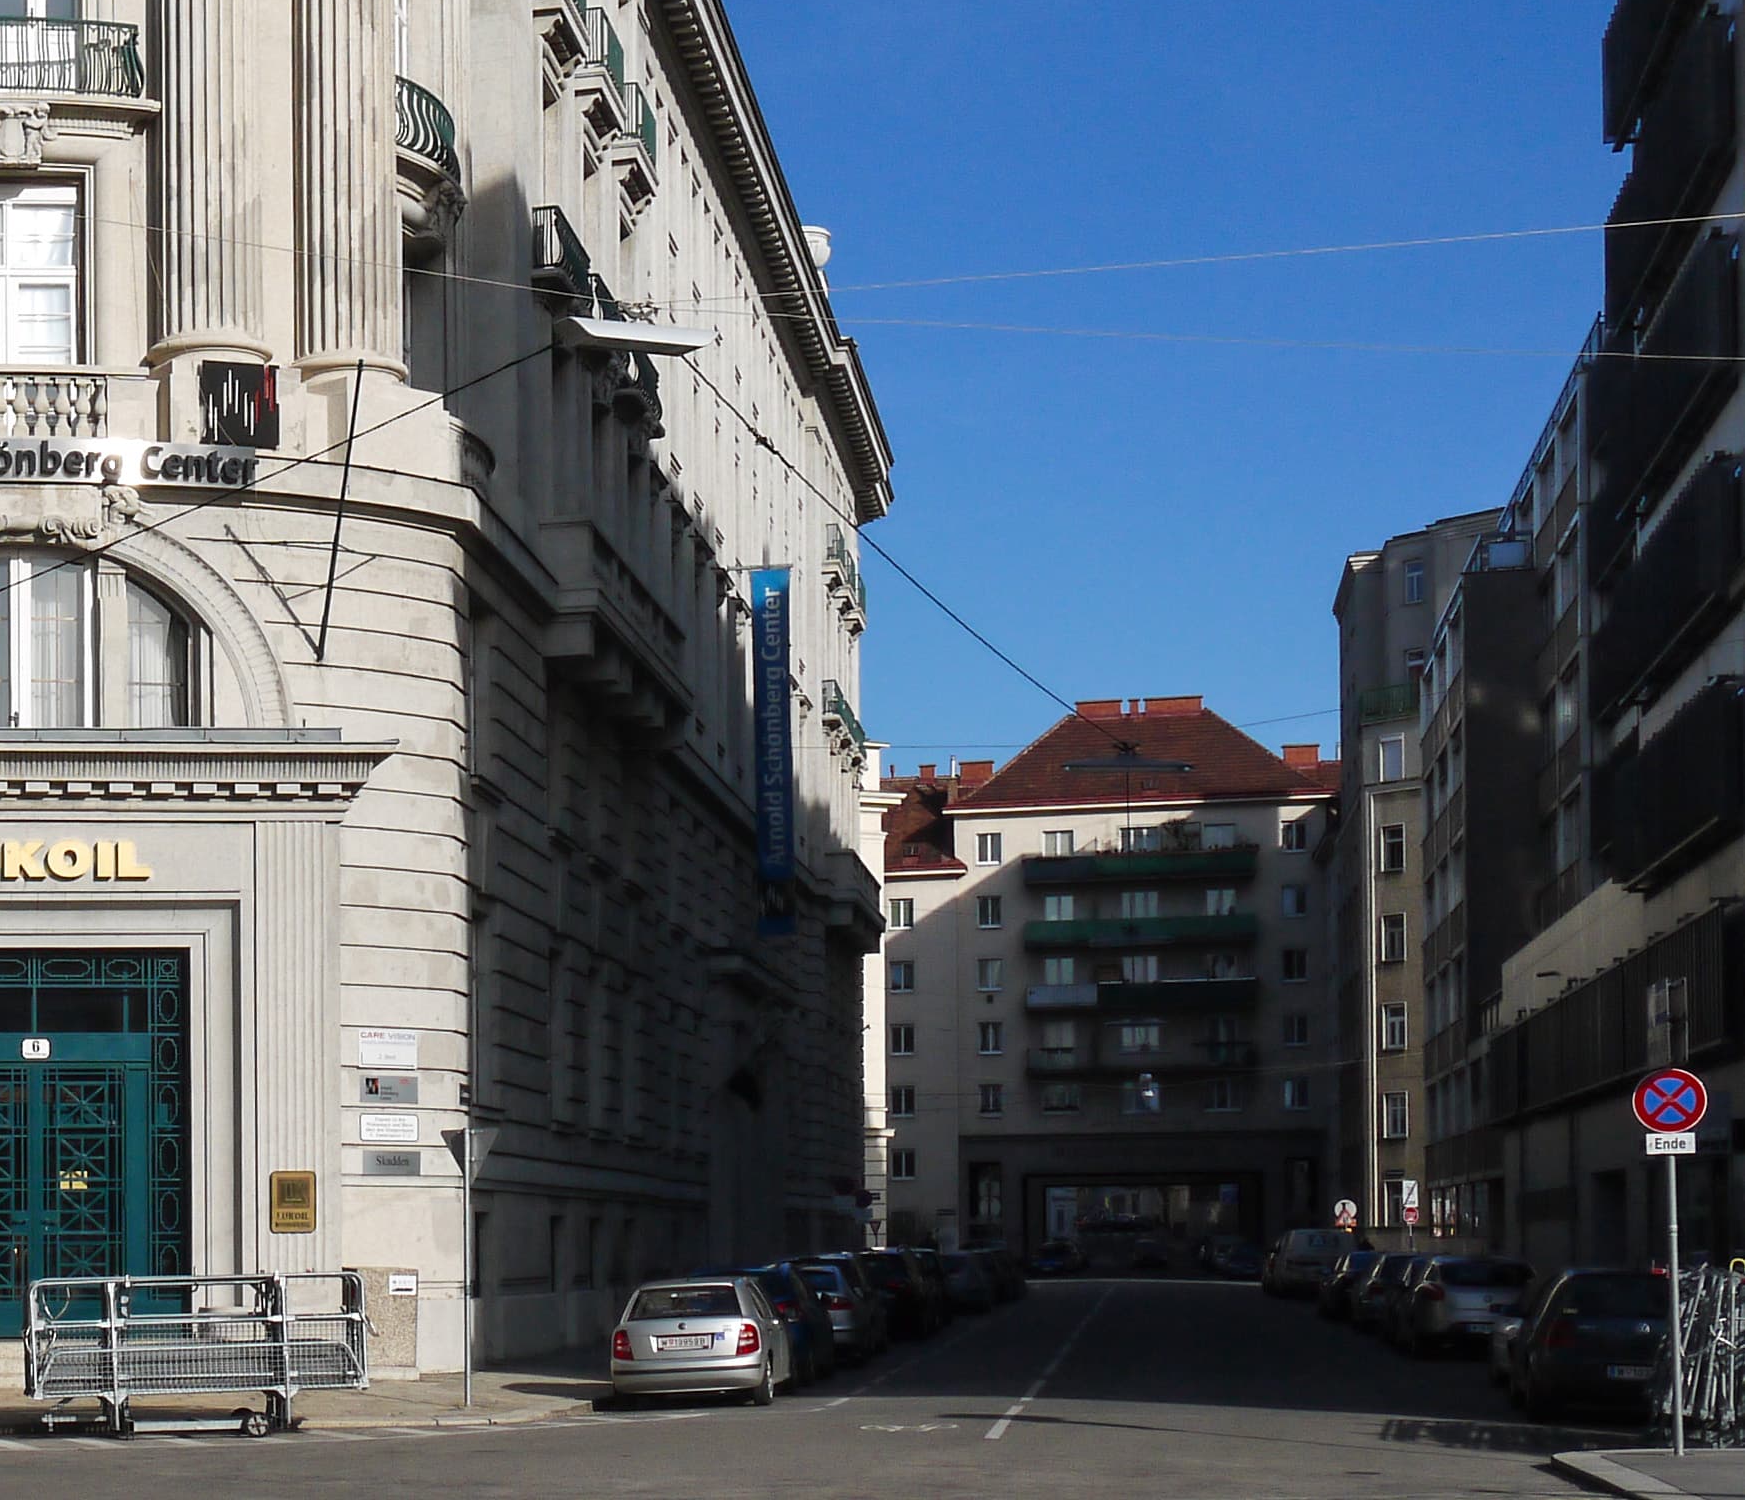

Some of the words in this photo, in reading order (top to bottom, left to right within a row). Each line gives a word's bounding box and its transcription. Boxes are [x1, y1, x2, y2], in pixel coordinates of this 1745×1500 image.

[141, 445, 260, 486] Center
[761, 586, 782, 663] Center
[761, 666, 788, 786] Schönberg
[763, 790, 784, 867] Arnold
[32, 1040, 40, 1052] 6
[1654, 1137, 1687, 1150] Ende
